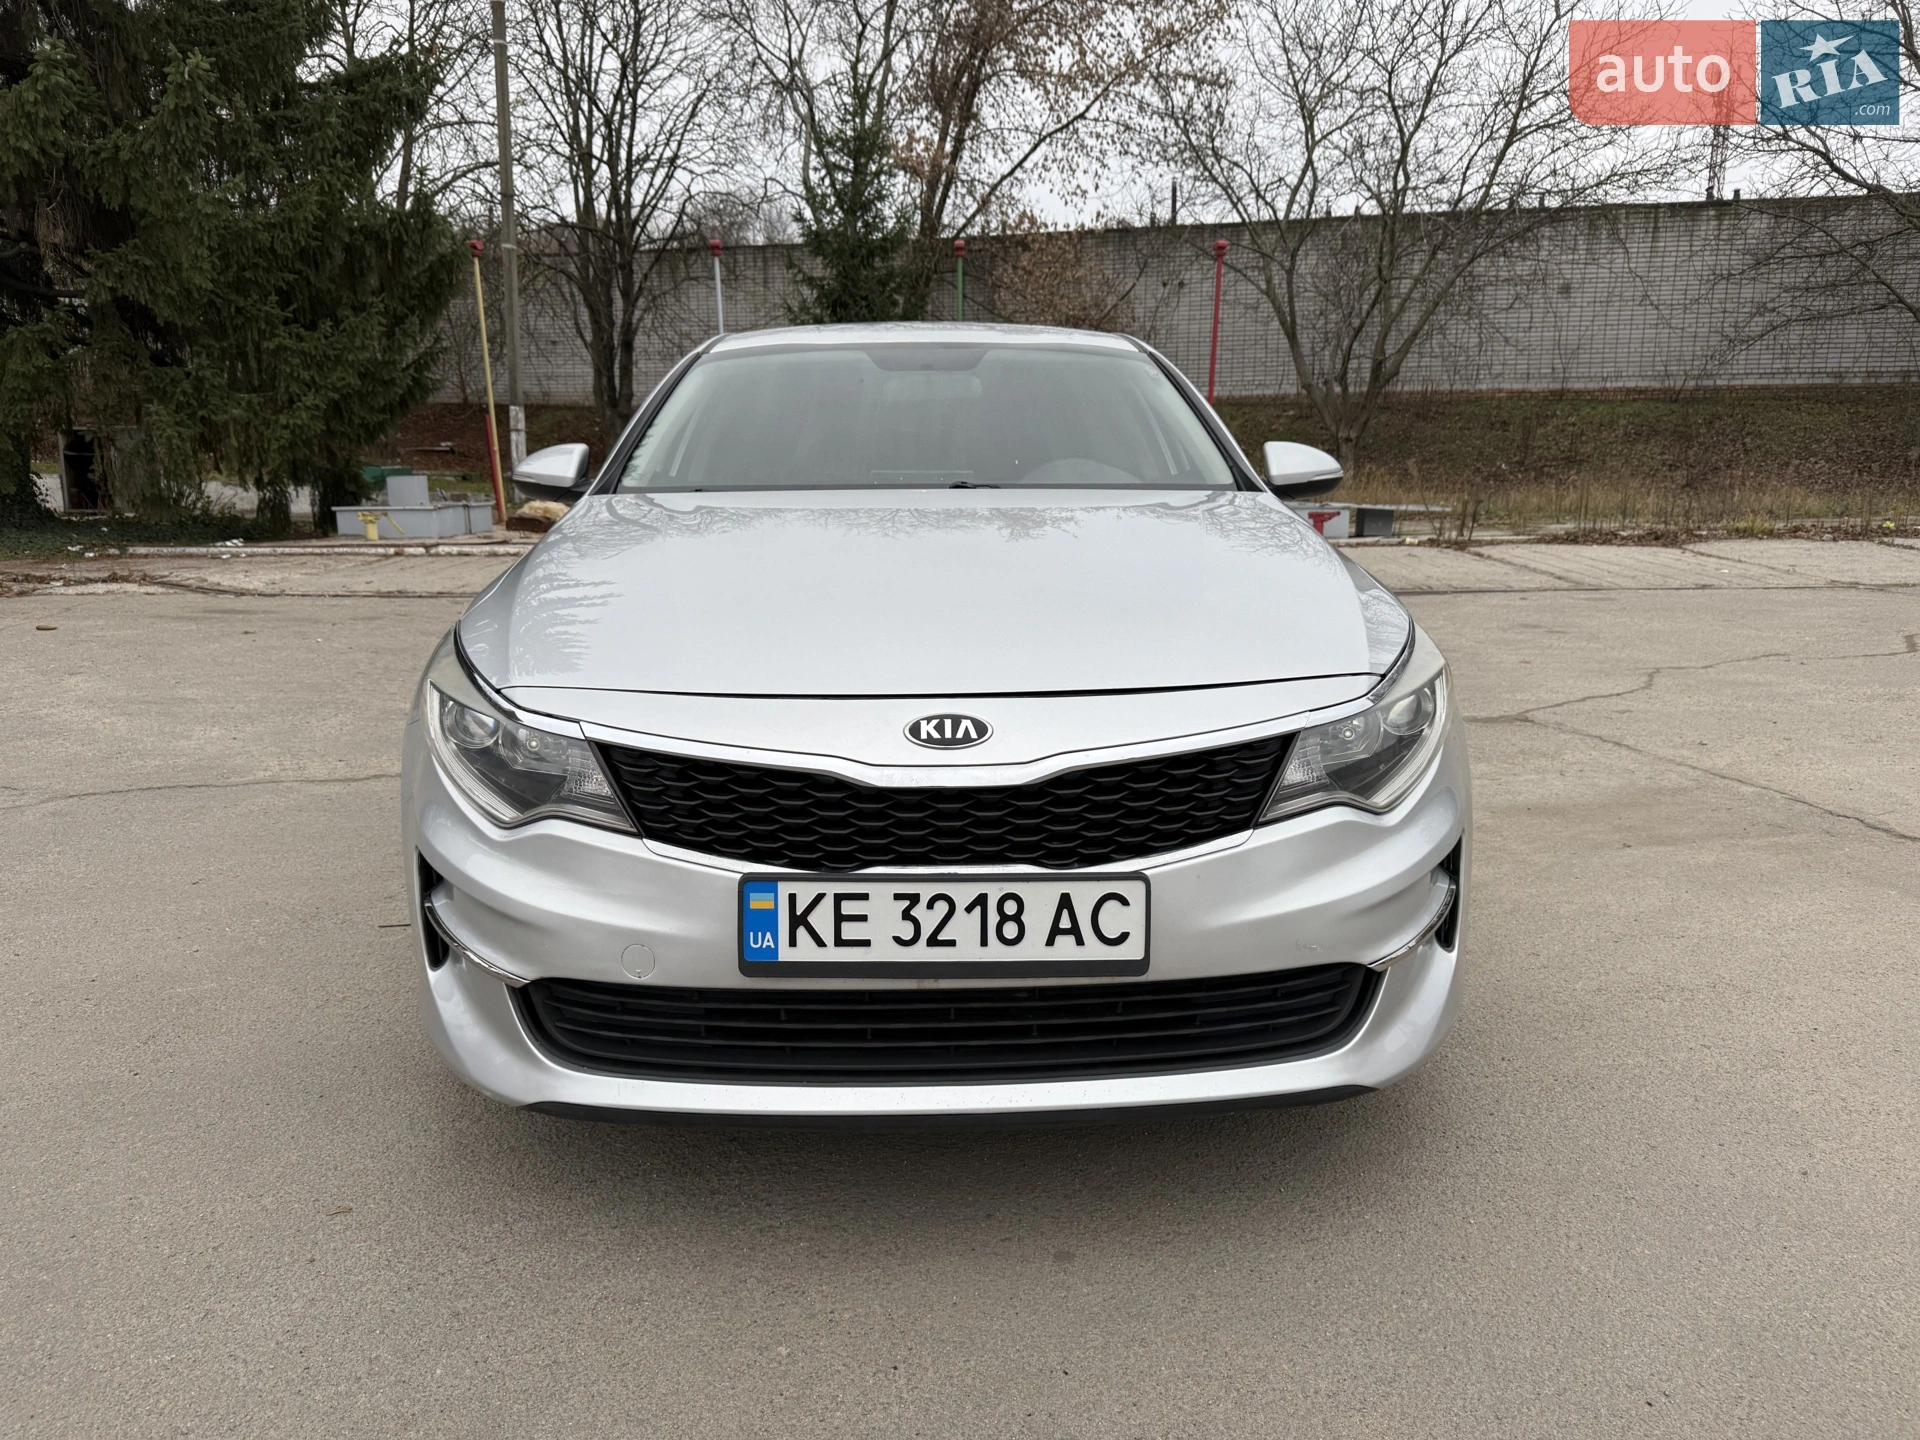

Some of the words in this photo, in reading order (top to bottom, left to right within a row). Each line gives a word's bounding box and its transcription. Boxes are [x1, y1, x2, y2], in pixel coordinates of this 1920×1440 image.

[919, 718, 978, 740] KIA
[787, 892, 872, 948] KE
[891, 892, 1026, 947] 3218
[1045, 892, 1131, 947] AC
[749, 931, 775, 949] UA
